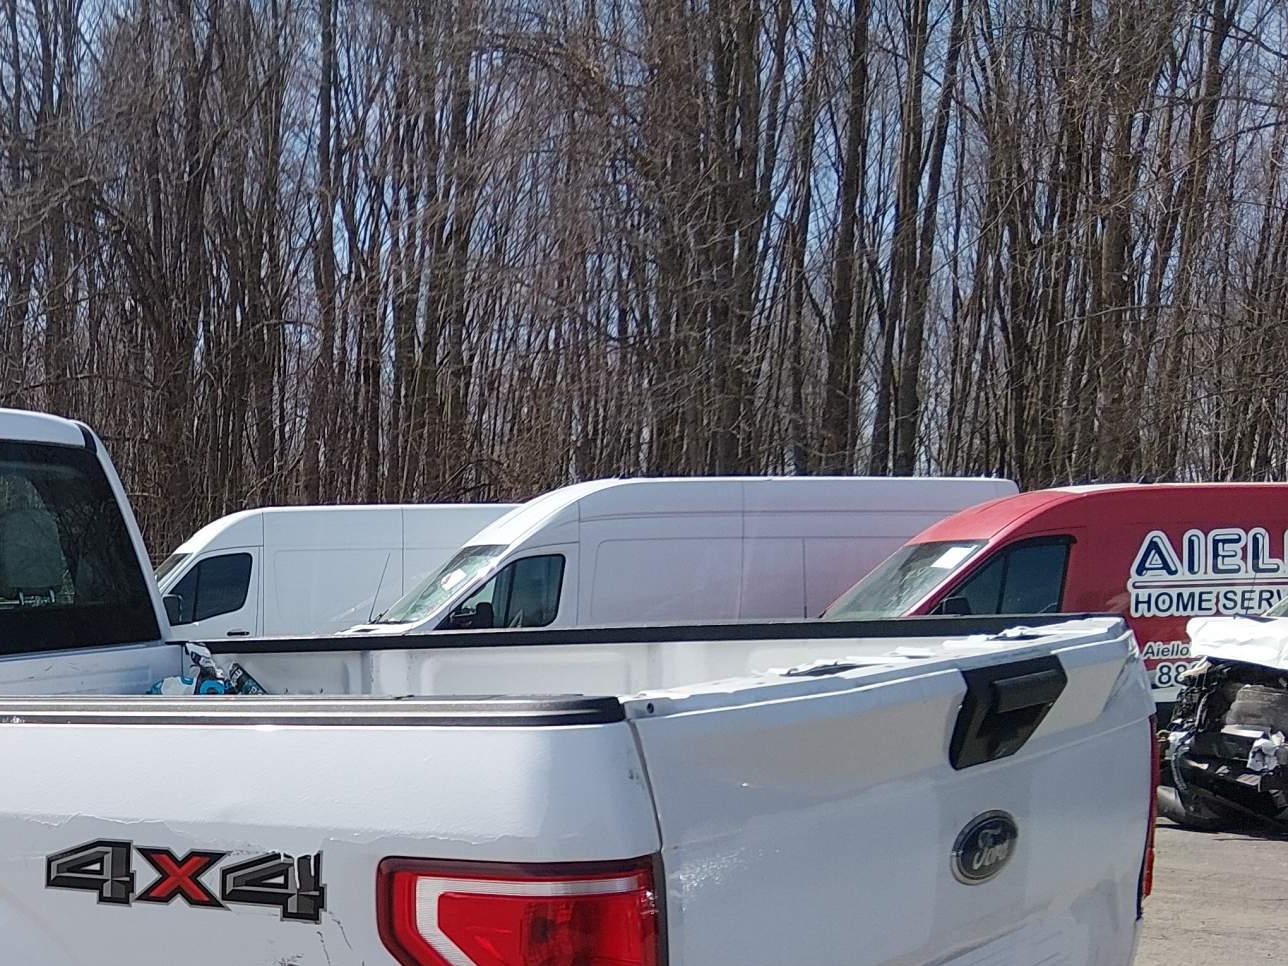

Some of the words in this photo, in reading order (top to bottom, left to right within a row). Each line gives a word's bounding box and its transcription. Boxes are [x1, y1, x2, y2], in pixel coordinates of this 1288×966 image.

[1133, 529, 1288, 577] AIEL
[1134, 592, 1213, 613] HOME
[1143, 643, 1190, 658] Aiello
[1157, 664, 1200, 686] 88
